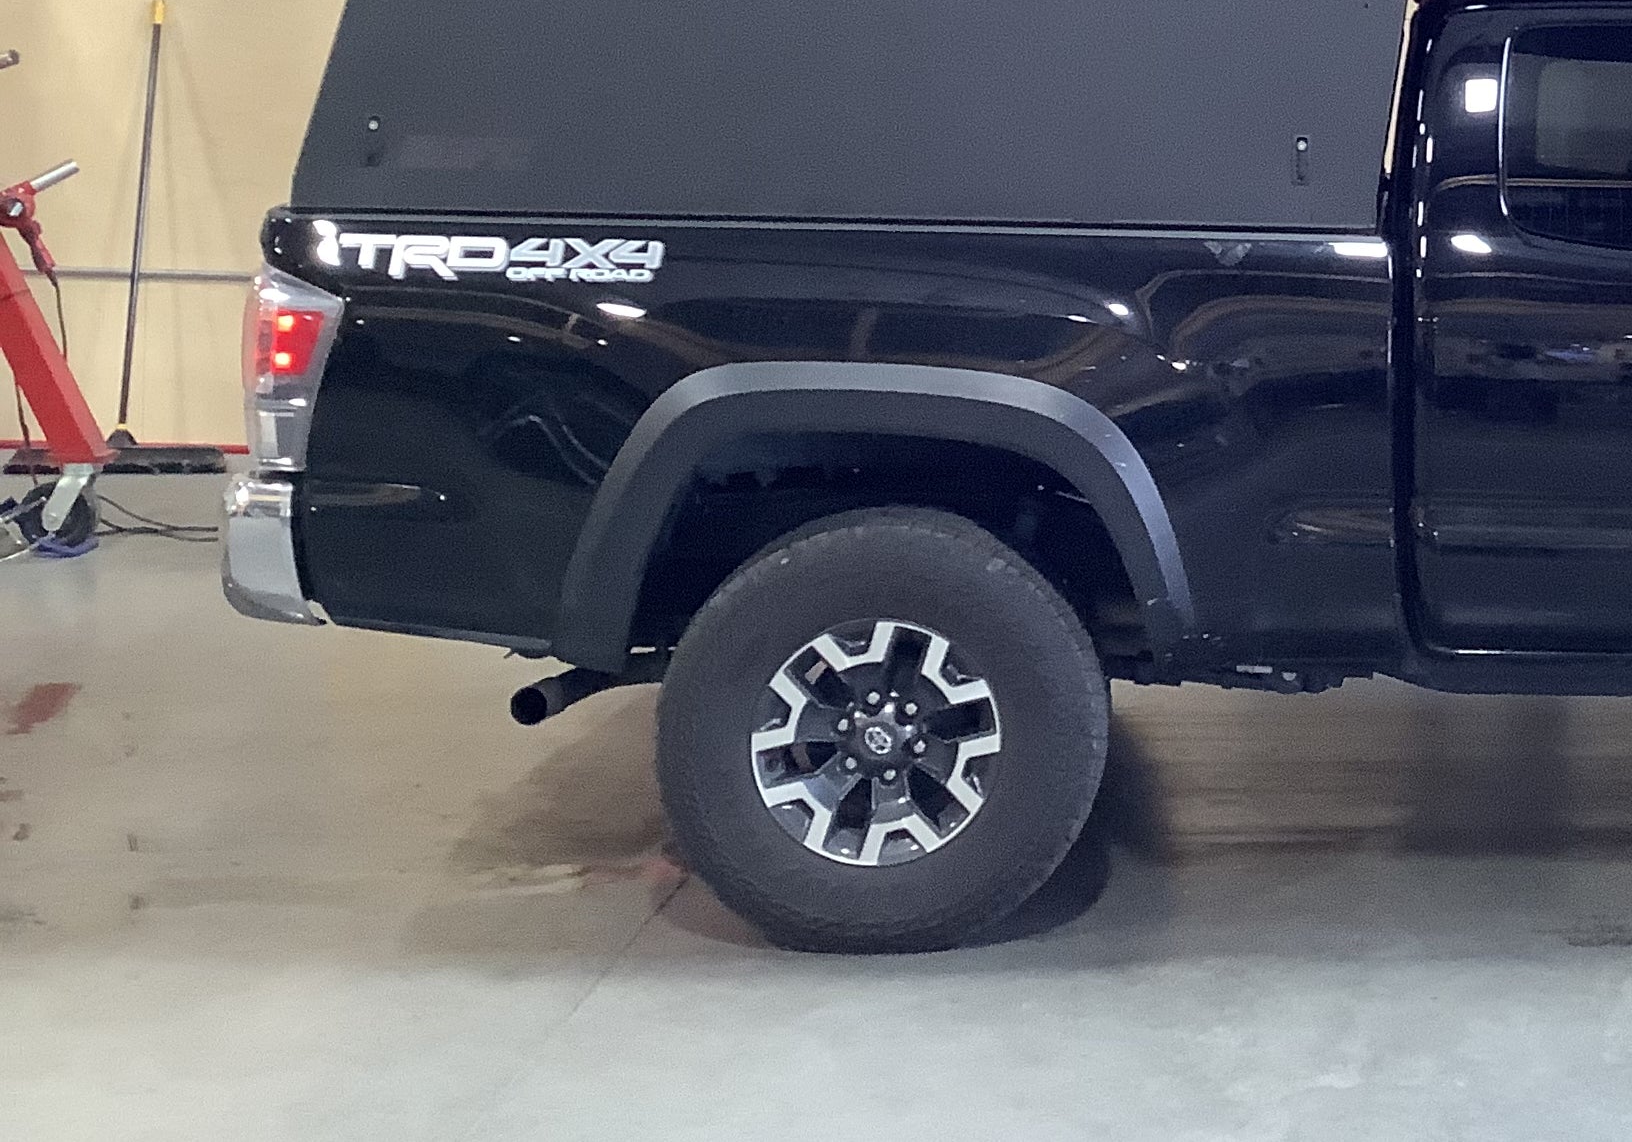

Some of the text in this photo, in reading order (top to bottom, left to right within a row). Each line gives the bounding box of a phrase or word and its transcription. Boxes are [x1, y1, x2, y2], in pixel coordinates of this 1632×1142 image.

[338, 233, 509, 281] TRD
[506, 266, 654, 283] OFF ROAD
